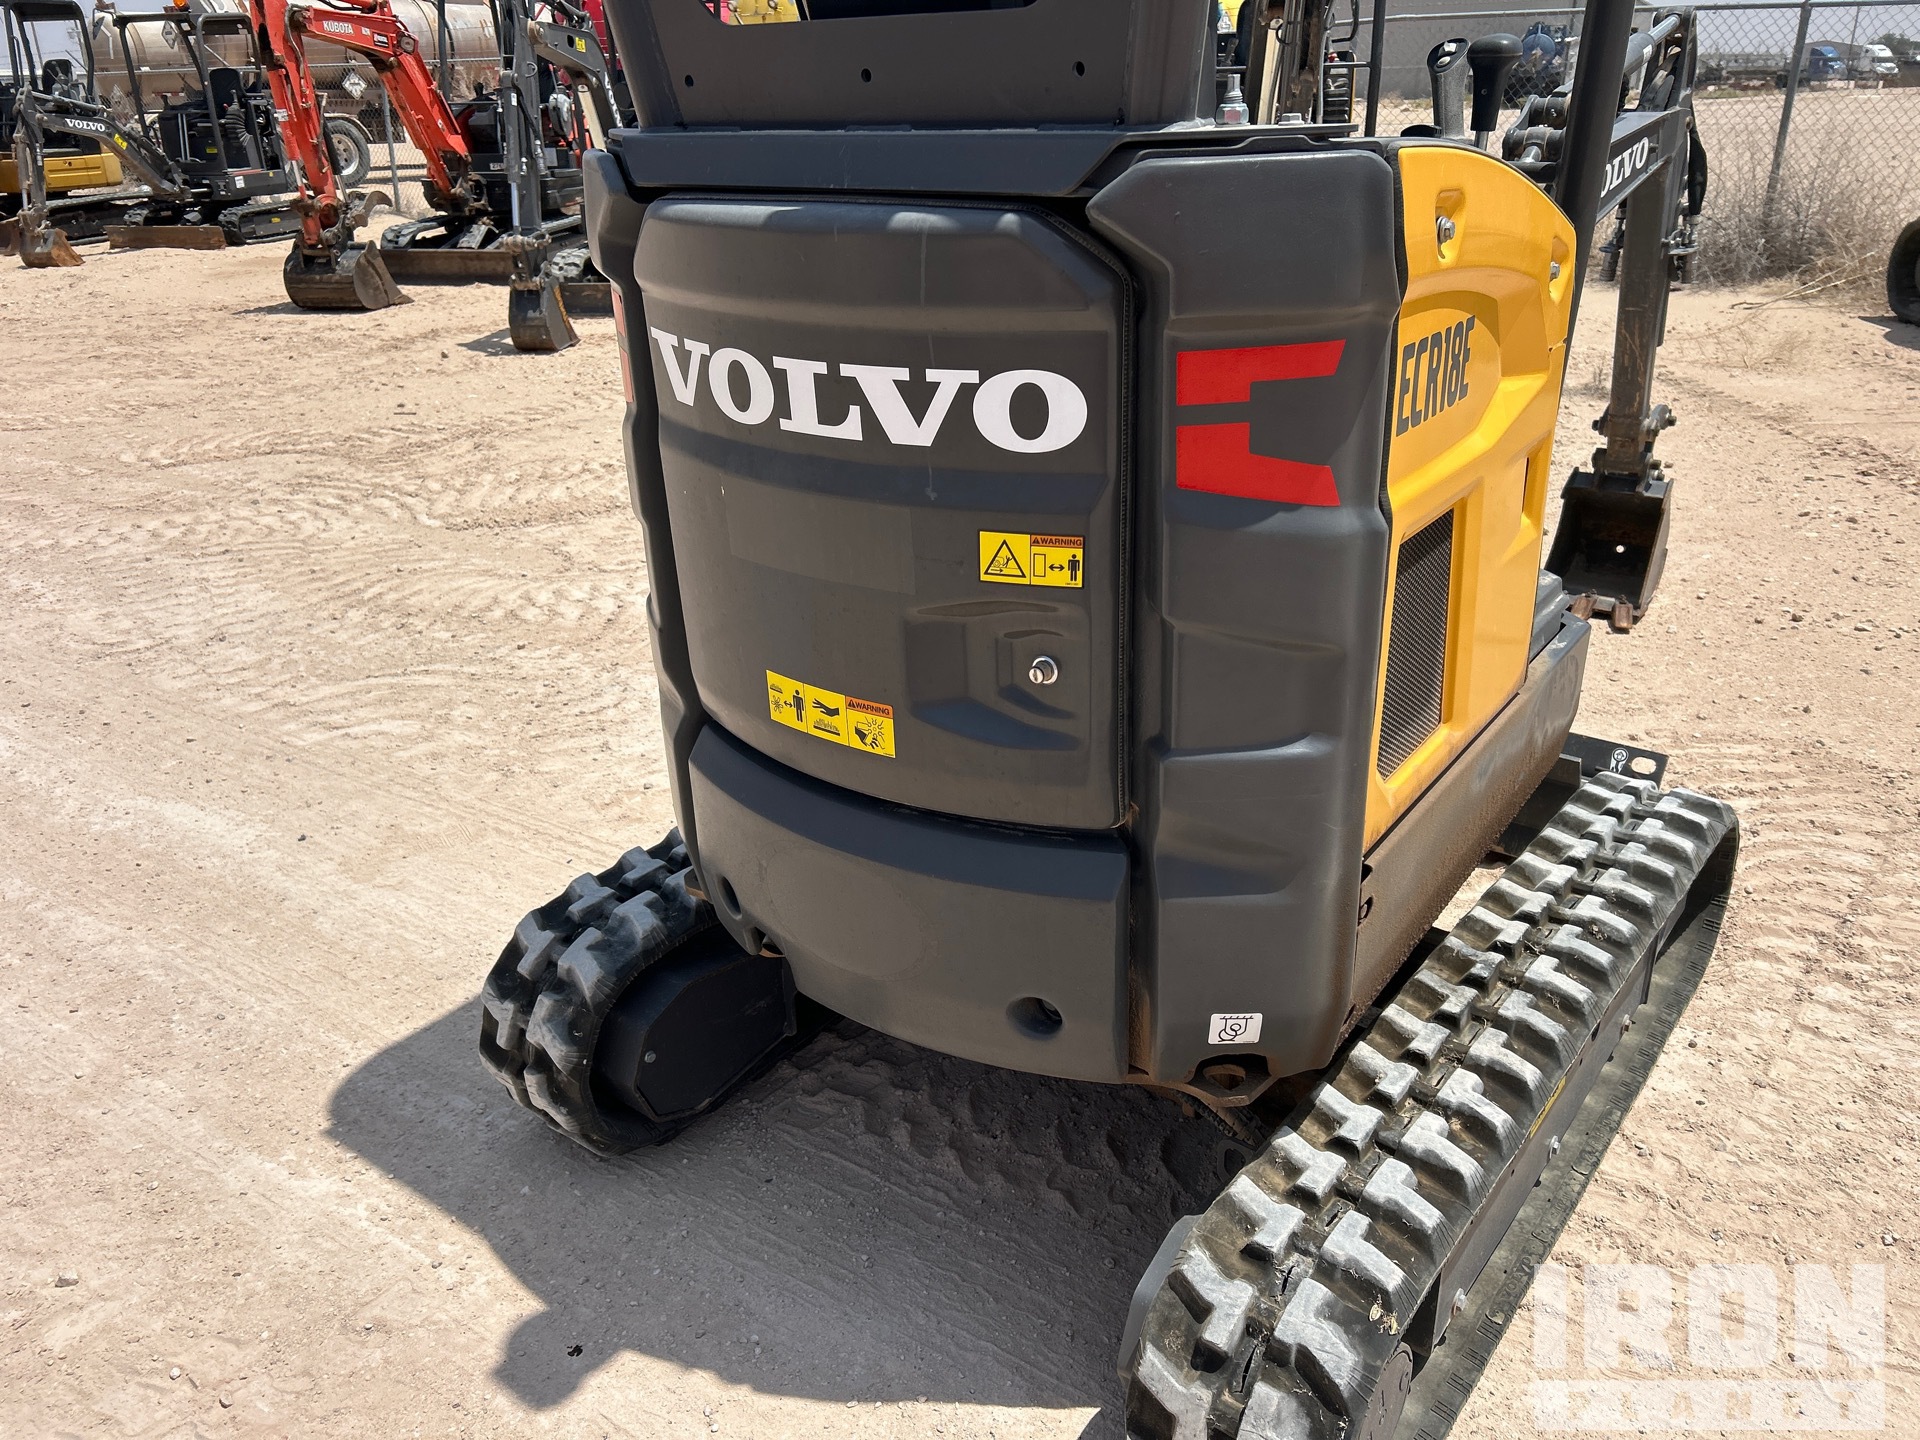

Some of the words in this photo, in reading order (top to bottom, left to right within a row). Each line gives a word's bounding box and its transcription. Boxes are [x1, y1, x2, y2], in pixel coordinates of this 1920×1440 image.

[322, 20, 355, 35] KUBOTA
[604, 71, 624, 130] VOLV
[65, 117, 106, 132] VOLVO
[1600, 136, 1649, 198] OLVO
[650, 326, 1088, 454] VOLVO
[1396, 314, 1476, 437] ECR18E
[1040, 536, 1082, 547] WARNING
[854, 701, 890, 716] WARNING
